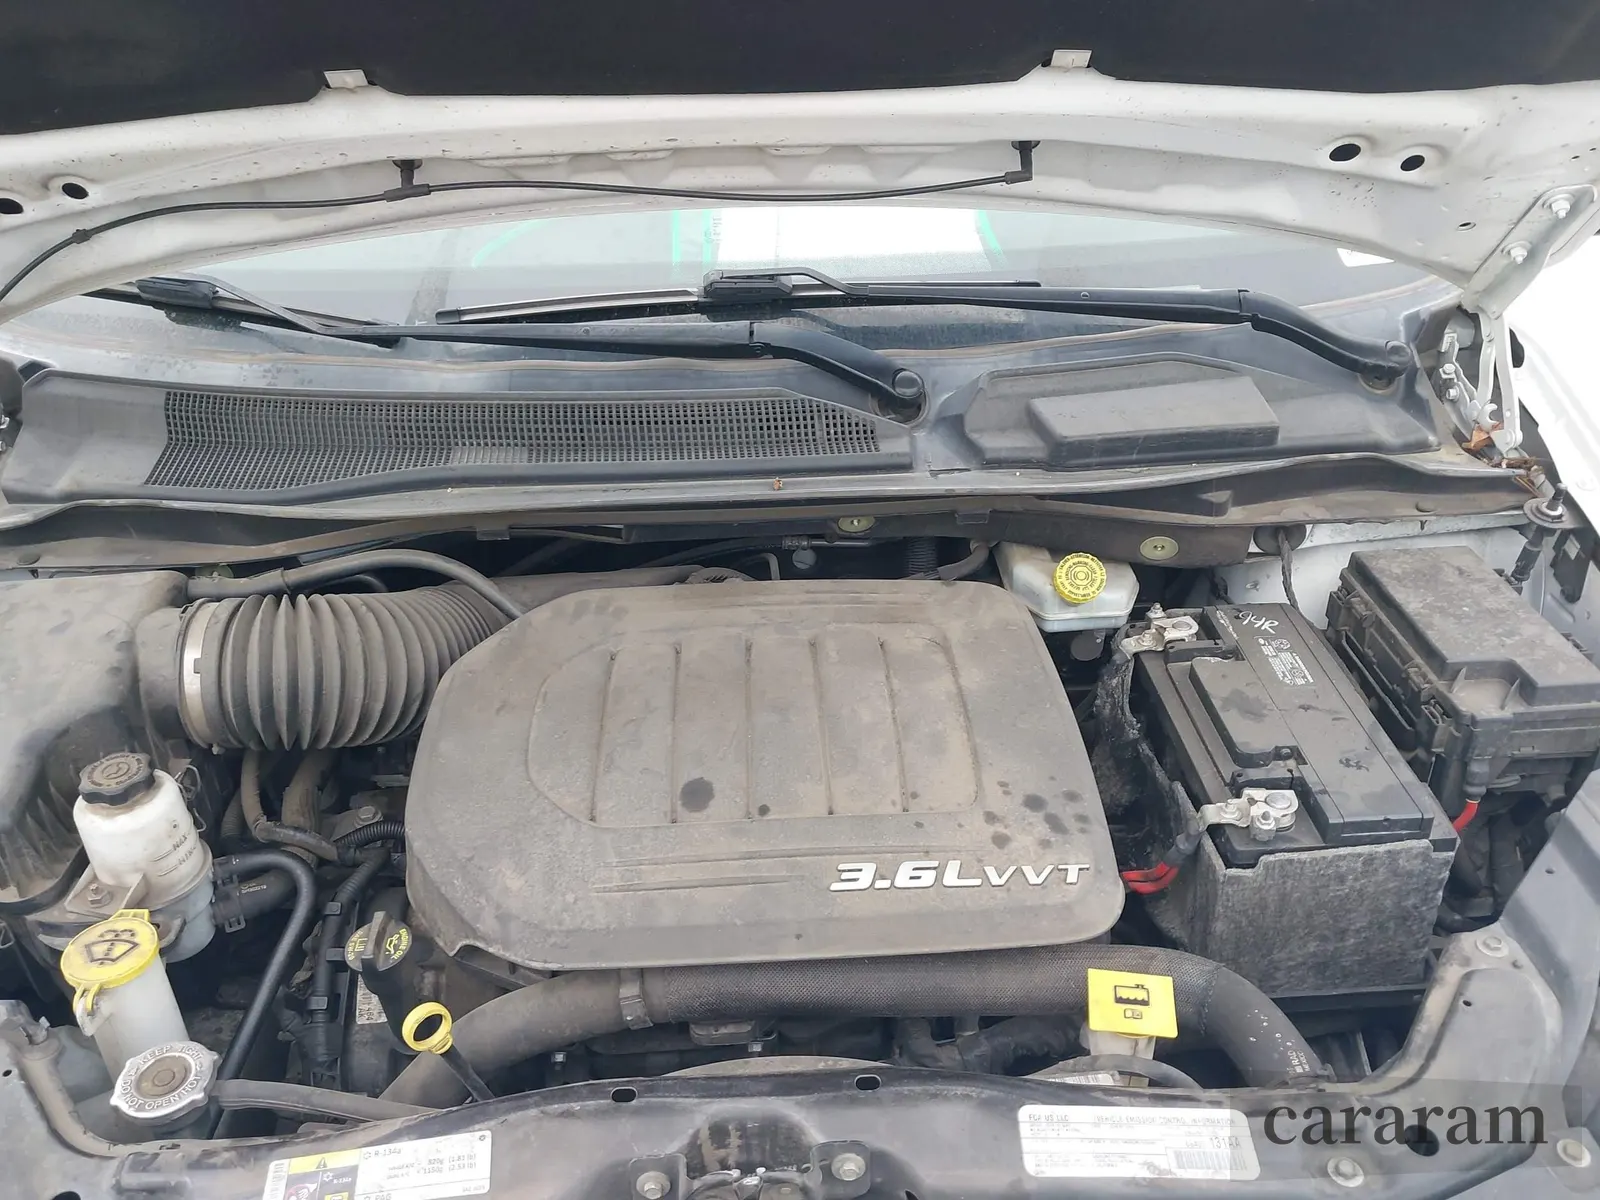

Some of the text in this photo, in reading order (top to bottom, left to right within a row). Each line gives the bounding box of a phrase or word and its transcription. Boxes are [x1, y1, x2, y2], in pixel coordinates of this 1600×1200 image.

[983, 864, 1090, 887] VVT
[391, 928, 409, 960] ENGINE OIL
[139, 1045, 171, 1065] KEEP
[121, 1075, 201, 1110] DO NOT OPEN HOT
